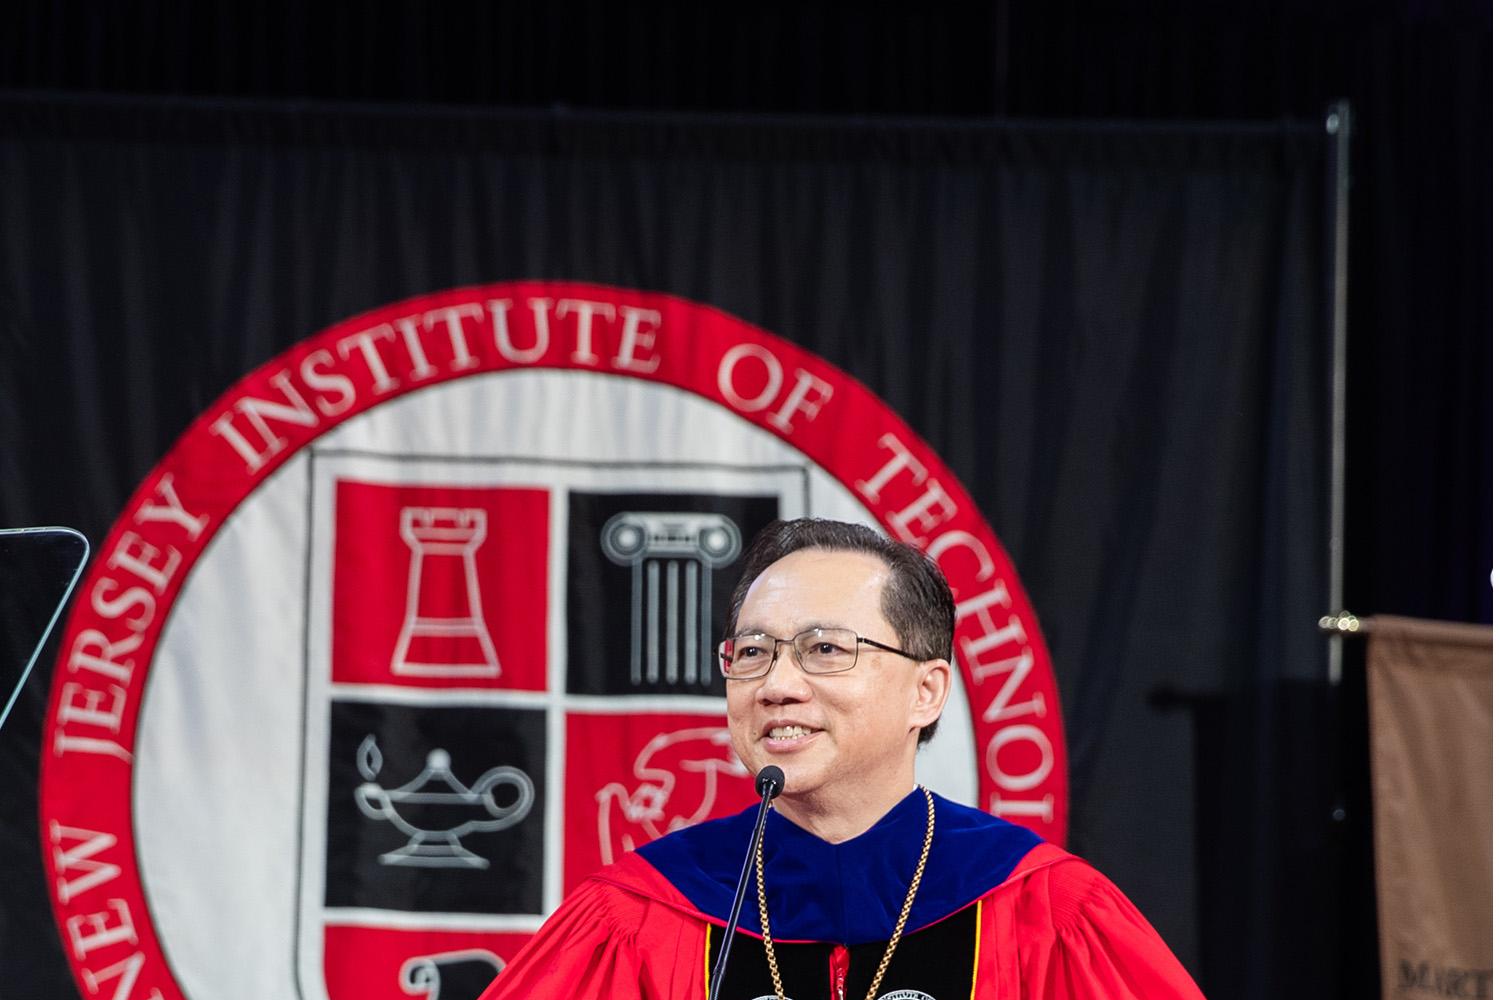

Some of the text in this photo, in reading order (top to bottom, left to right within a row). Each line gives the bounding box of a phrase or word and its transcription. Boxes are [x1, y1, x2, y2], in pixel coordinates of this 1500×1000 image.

[53, 471, 211, 764] JERSEY
[209, 298, 662, 475] INSTITUTE
[716, 342, 834, 434] OF
